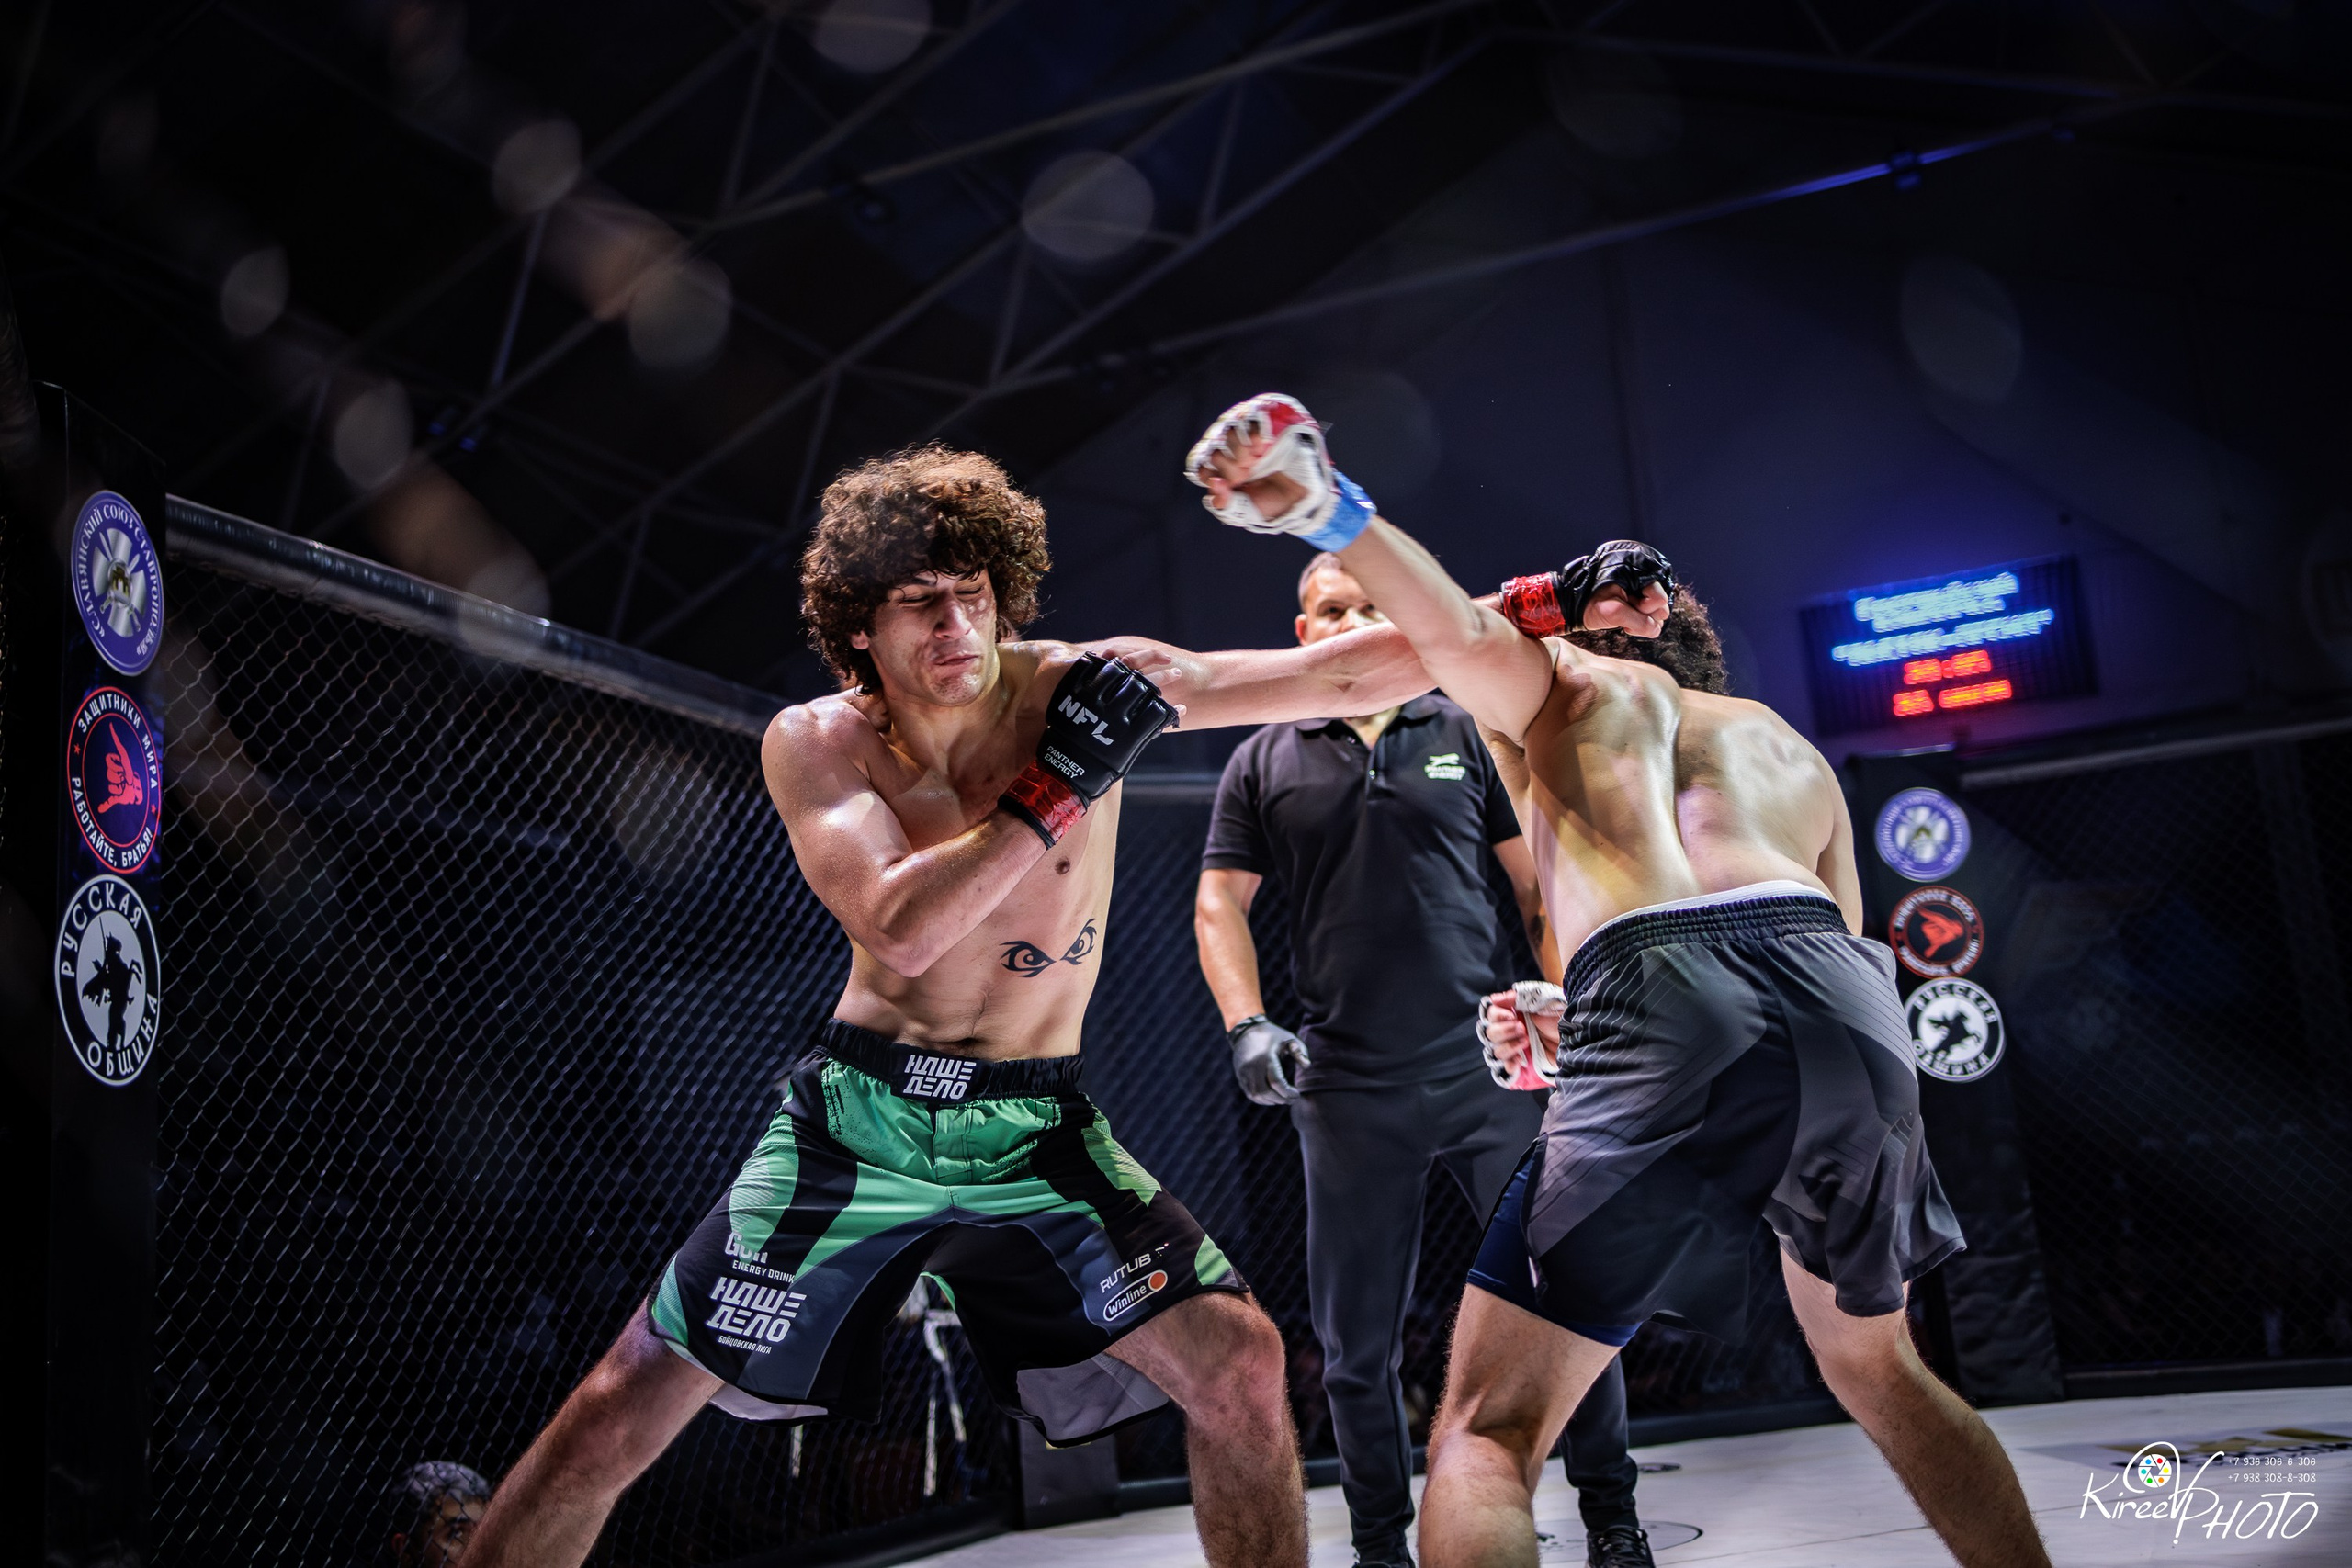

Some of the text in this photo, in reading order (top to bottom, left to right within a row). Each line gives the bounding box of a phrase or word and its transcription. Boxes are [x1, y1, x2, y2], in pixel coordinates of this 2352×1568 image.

[103, 504, 133, 530] СОЮЗ
[1058, 695, 1114, 746] NFL
[78, 694, 158, 789] ЗАЩИТНИКИ МИРА
[1044, 753, 1079, 779] ENERGY
[1046, 745, 1085, 776] PANTHER
[122, 827, 153, 867] БРАТЬЯ!
[61, 883, 142, 977] РУССКАЯ
[87, 992, 158, 1077] ОБЩИНА
[903, 1076, 967, 1100] ДЕЛО
[732, 1259, 796, 1283] ENERGY DRINK
[1100, 1247, 1165, 1293] RUTUB
[1108, 1284, 1147, 1316] Winline
[707, 1304, 791, 1343] ДЕЛО
[718, 1335, 772, 1354] БОЙЦОВСКАЯ ЛИГА
